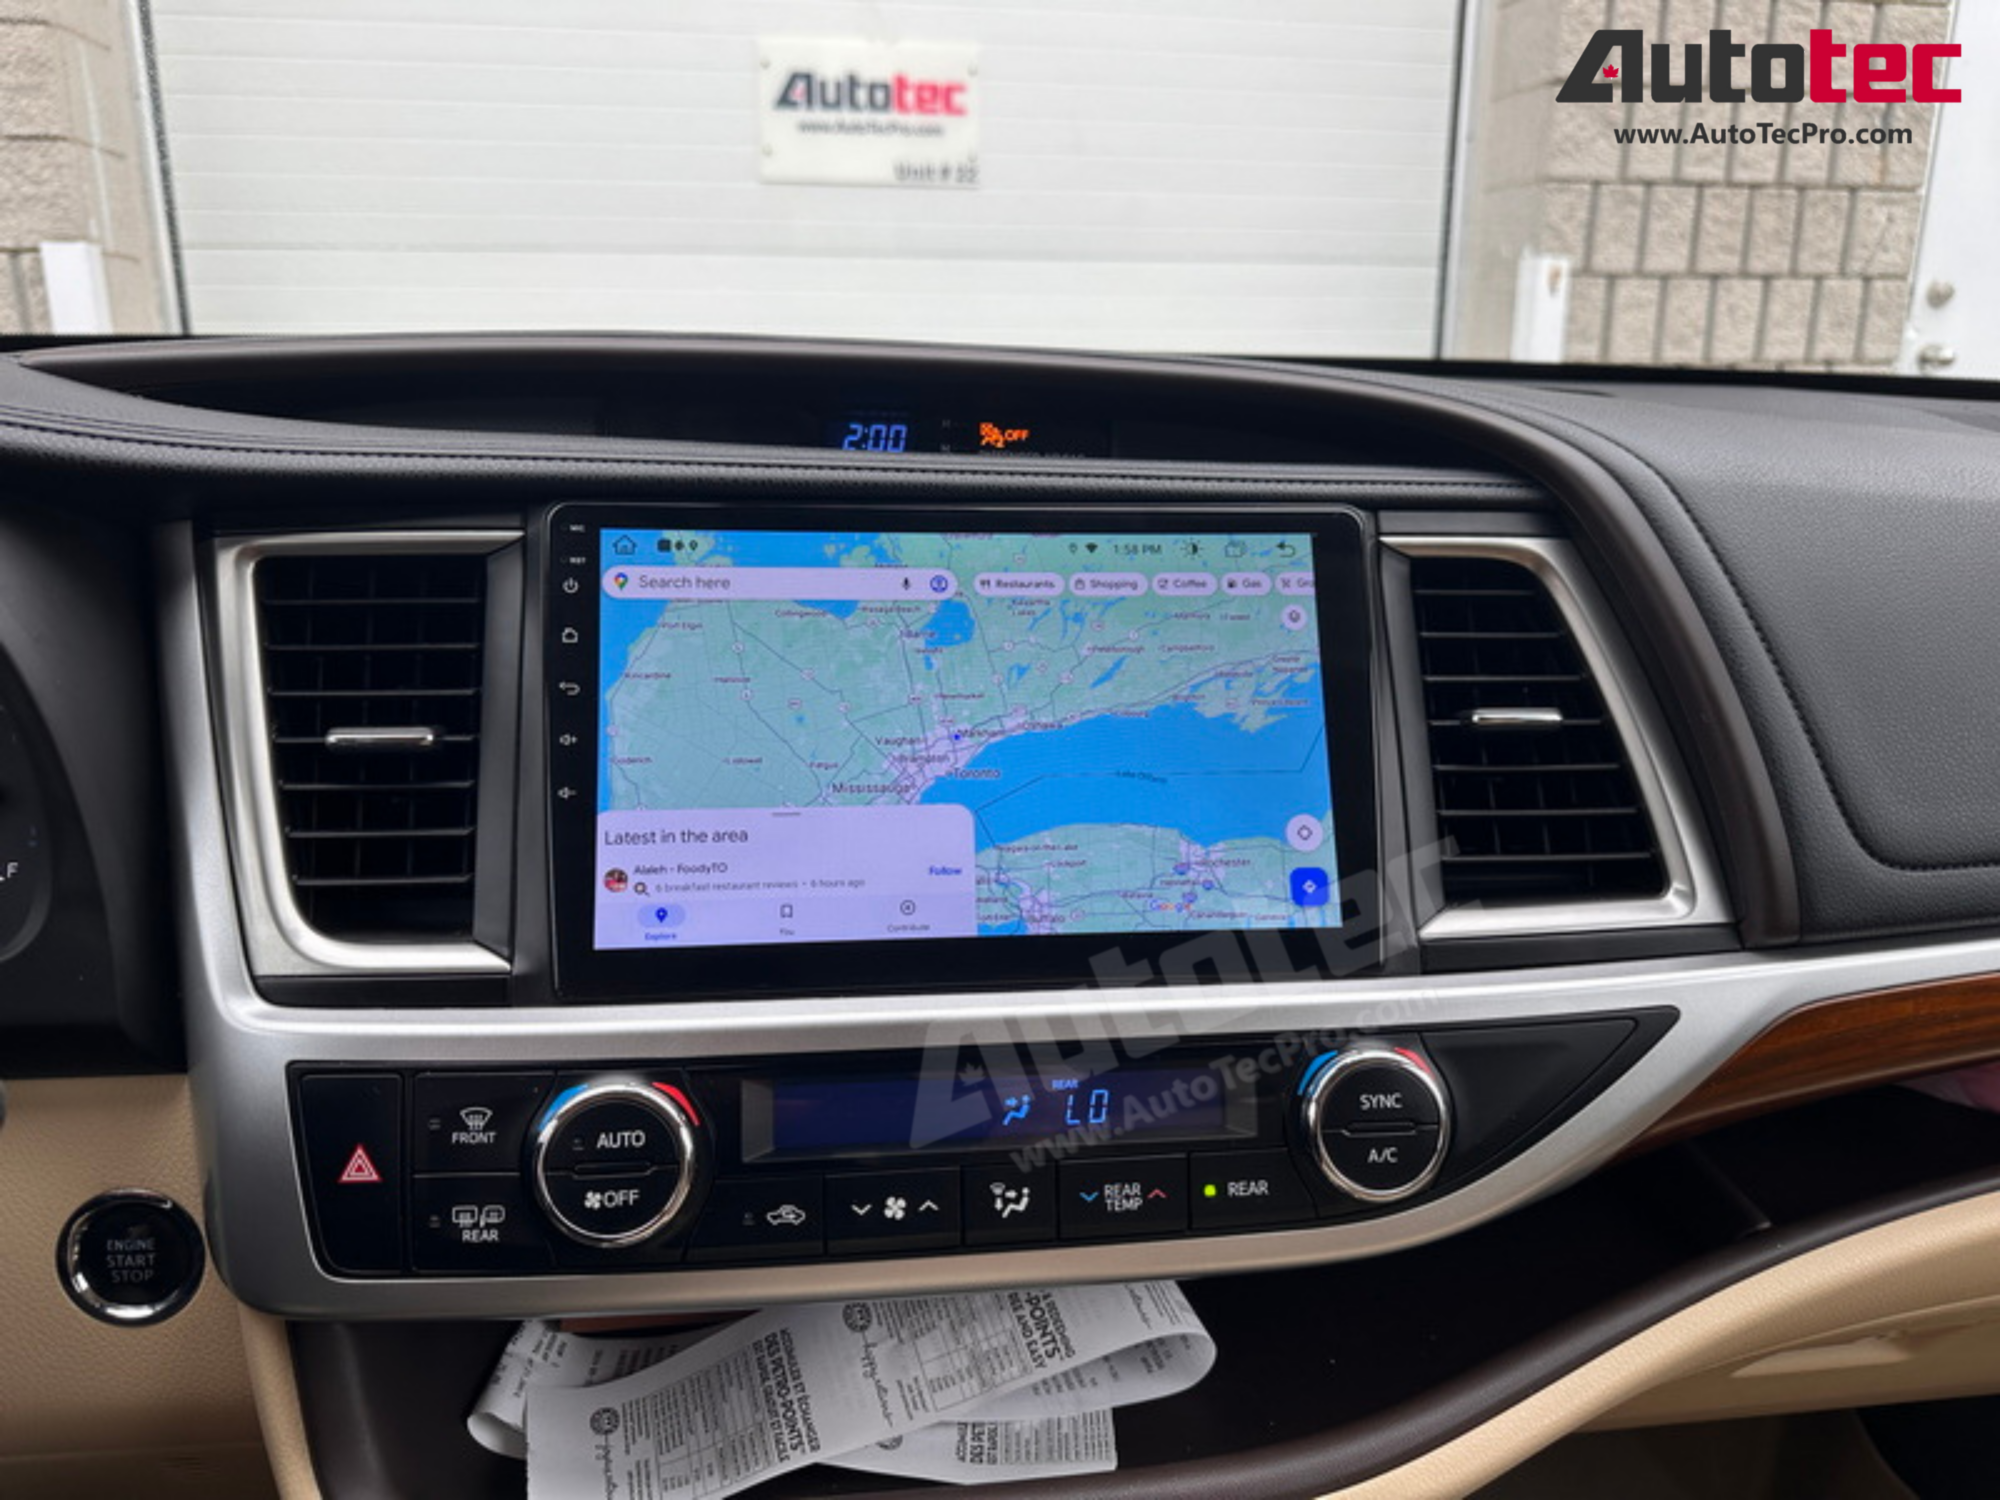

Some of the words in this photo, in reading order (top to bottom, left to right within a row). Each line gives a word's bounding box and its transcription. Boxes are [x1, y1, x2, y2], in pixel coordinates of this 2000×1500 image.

[774, 71, 968, 117] Autotec
[843, 423, 907, 452] 2:00
[1004, 429, 1029, 441] OFF
[1113, 543, 1138, 555] 1:58
[1142, 543, 1162, 555] PM
[638, 575, 692, 589] Search
[695, 575, 731, 589] here
[995, 579, 1056, 589] Restaurants
[1089, 579, 1138, 591] Shopping
[1172, 579, 1208, 589] Coffee
[1242, 580, 1262, 589] Gas
[876, 735, 920, 747] Vaughan
[954, 767, 1001, 779] Toronto
[831, 781, 912, 796] Mississauga
[604, 829, 656, 846] Latest
[662, 829, 676, 844] in
[680, 828, 708, 844] the
[712, 831, 749, 844] area
[929, 864, 962, 876] Follow
[664, 882, 710, 893] breakfast
[712, 880, 761, 891] restaurant
[763, 880, 798, 890] reviews
[819, 878, 845, 888] hours
[848, 879, 865, 890] ago
[644, 932, 677, 942] Explore
[1052, 1078, 1079, 1090] REAR
[1359, 1092, 1403, 1110] SYNC
[451, 1132, 498, 1145] FRONT
[596, 1130, 646, 1150] AUTO
[1368, 1147, 1398, 1164] A/C
[1104, 1183, 1142, 1199] REAR
[1227, 1180, 1270, 1198] REAR
[603, 1189, 640, 1209] OFF
[1104, 1197, 1144, 1213] TEMP
[462, 1228, 499, 1243] REAR
[106, 1238, 156, 1251] ENGINE
[106, 1253, 156, 1268] START
[112, 1269, 154, 1283] STOP
[764, 1331, 781, 1358] DES
[1016, 1314, 1033, 1338] AND
[1025, 1339, 1047, 1368] EASY
